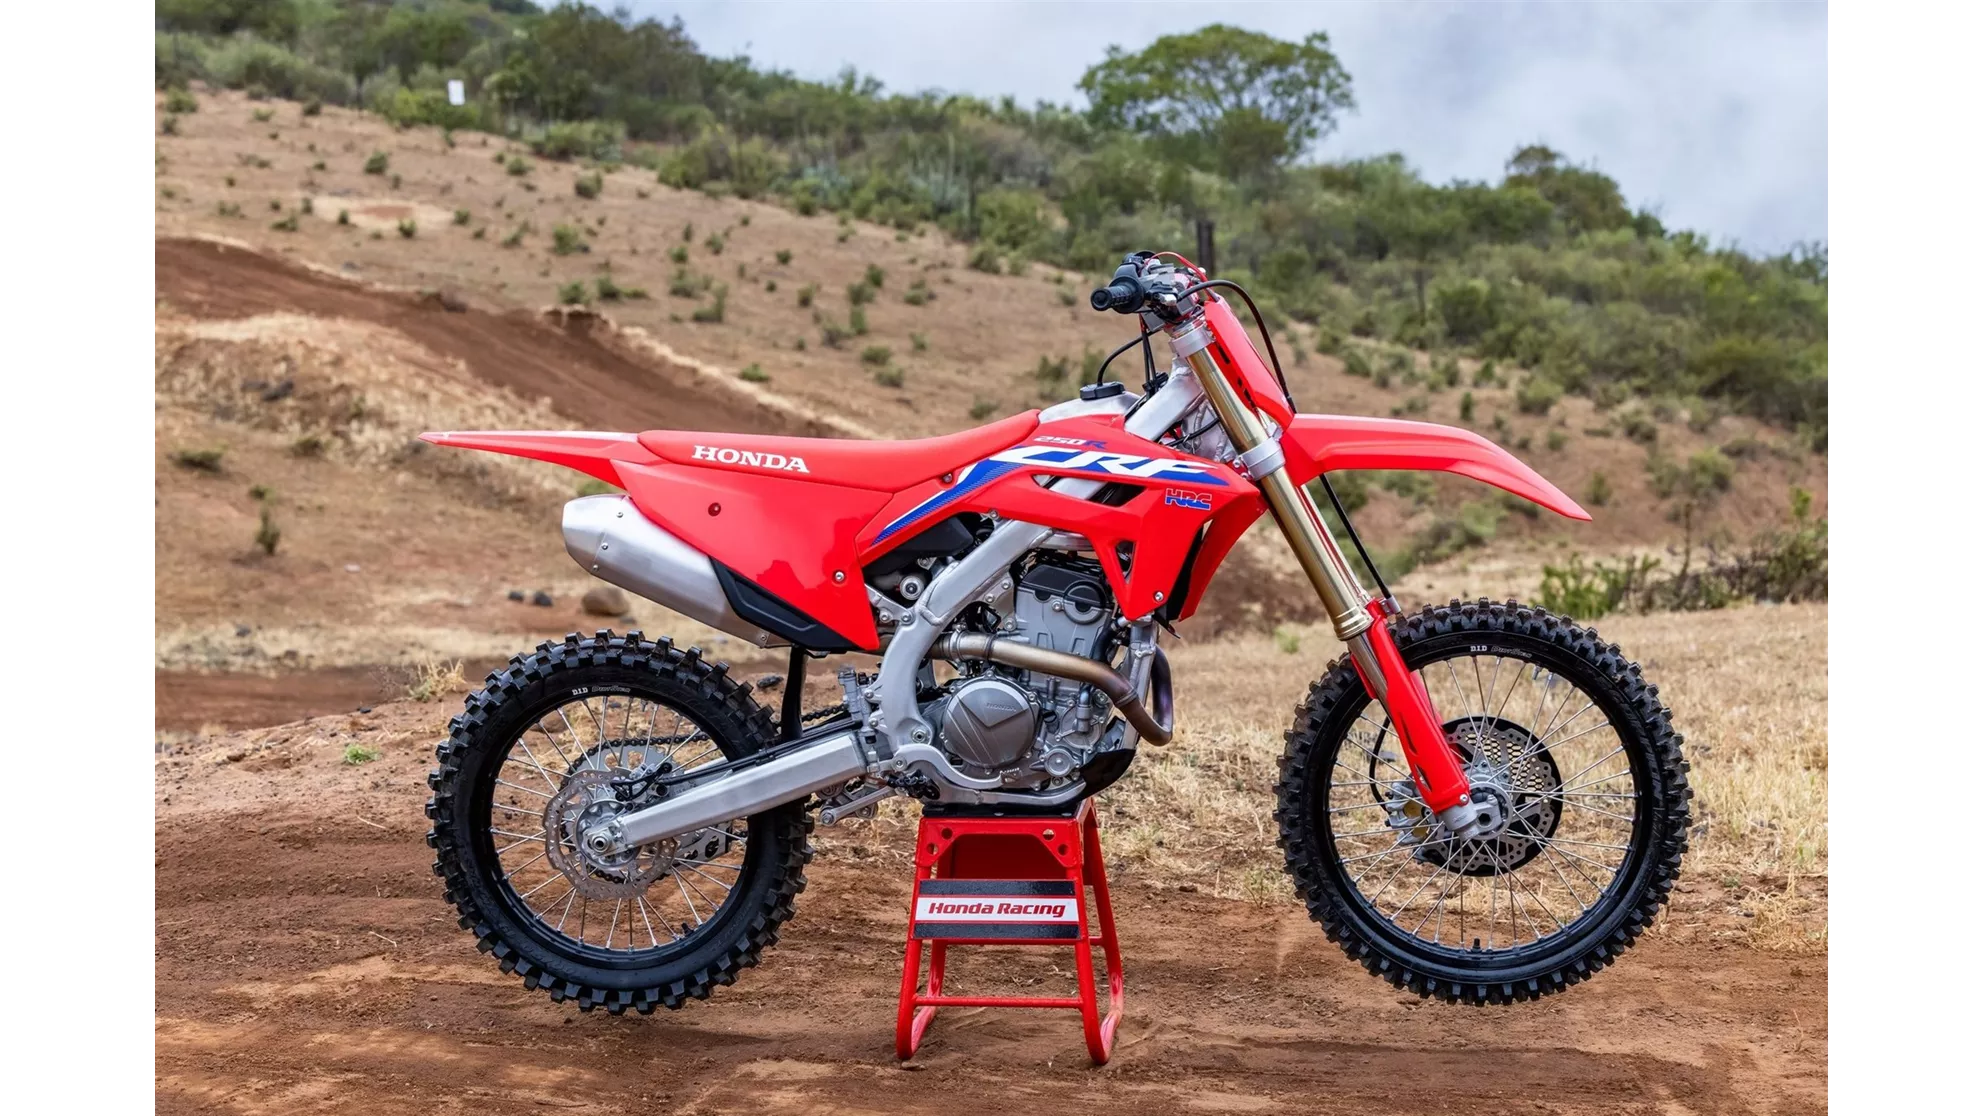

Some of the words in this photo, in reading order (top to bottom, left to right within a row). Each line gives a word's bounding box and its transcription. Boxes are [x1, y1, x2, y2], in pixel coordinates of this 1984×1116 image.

[1034, 435, 1107, 449] 250R
[691, 445, 810, 474] HONDA
[990, 445, 1219, 478] CRF
[1165, 487, 1213, 511] HRC
[928, 902, 995, 915] Honda
[997, 902, 1066, 918] Racing
